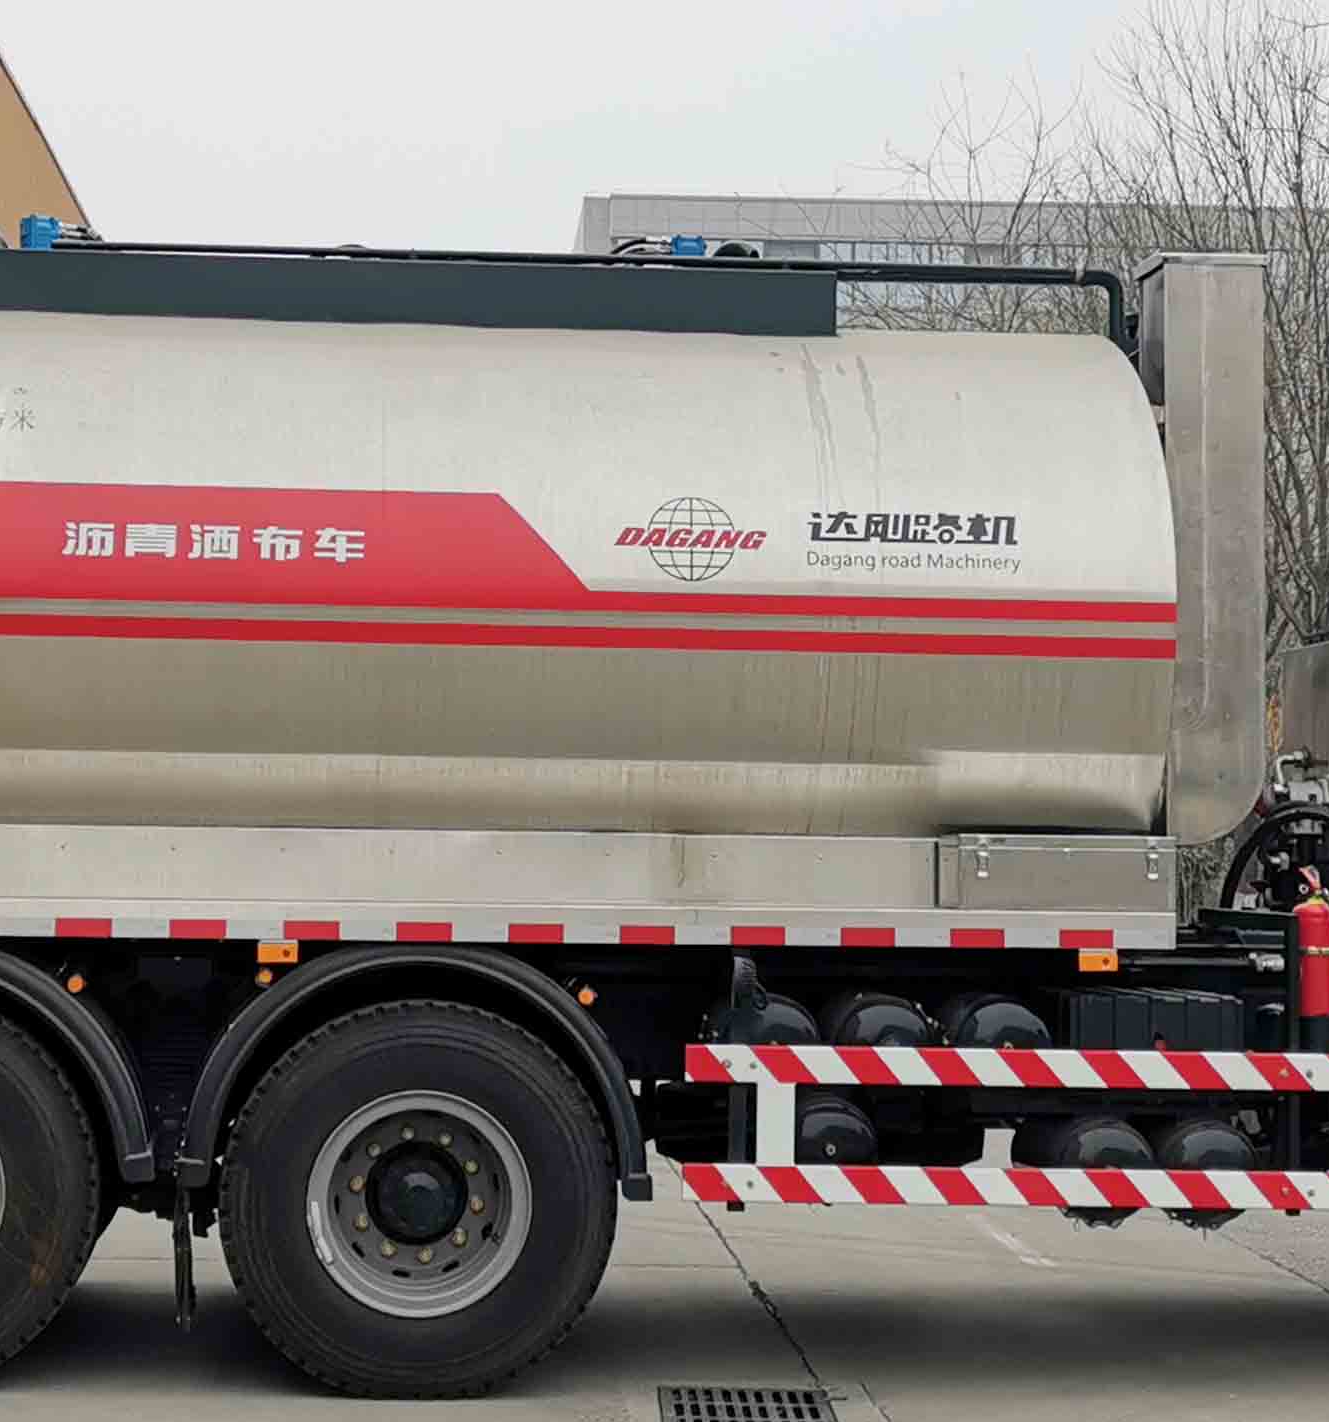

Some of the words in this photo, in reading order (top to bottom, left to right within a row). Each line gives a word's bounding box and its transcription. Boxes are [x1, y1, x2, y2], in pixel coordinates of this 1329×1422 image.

[62, 521, 366, 562] 沥青洒布车
[613, 527, 768, 551] DAGANG
[807, 511, 1019, 545] 达刚路机
[806, 551, 877, 571] Dagang
[881, 553, 923, 569] road
[927, 554, 1022, 573] Machinery
